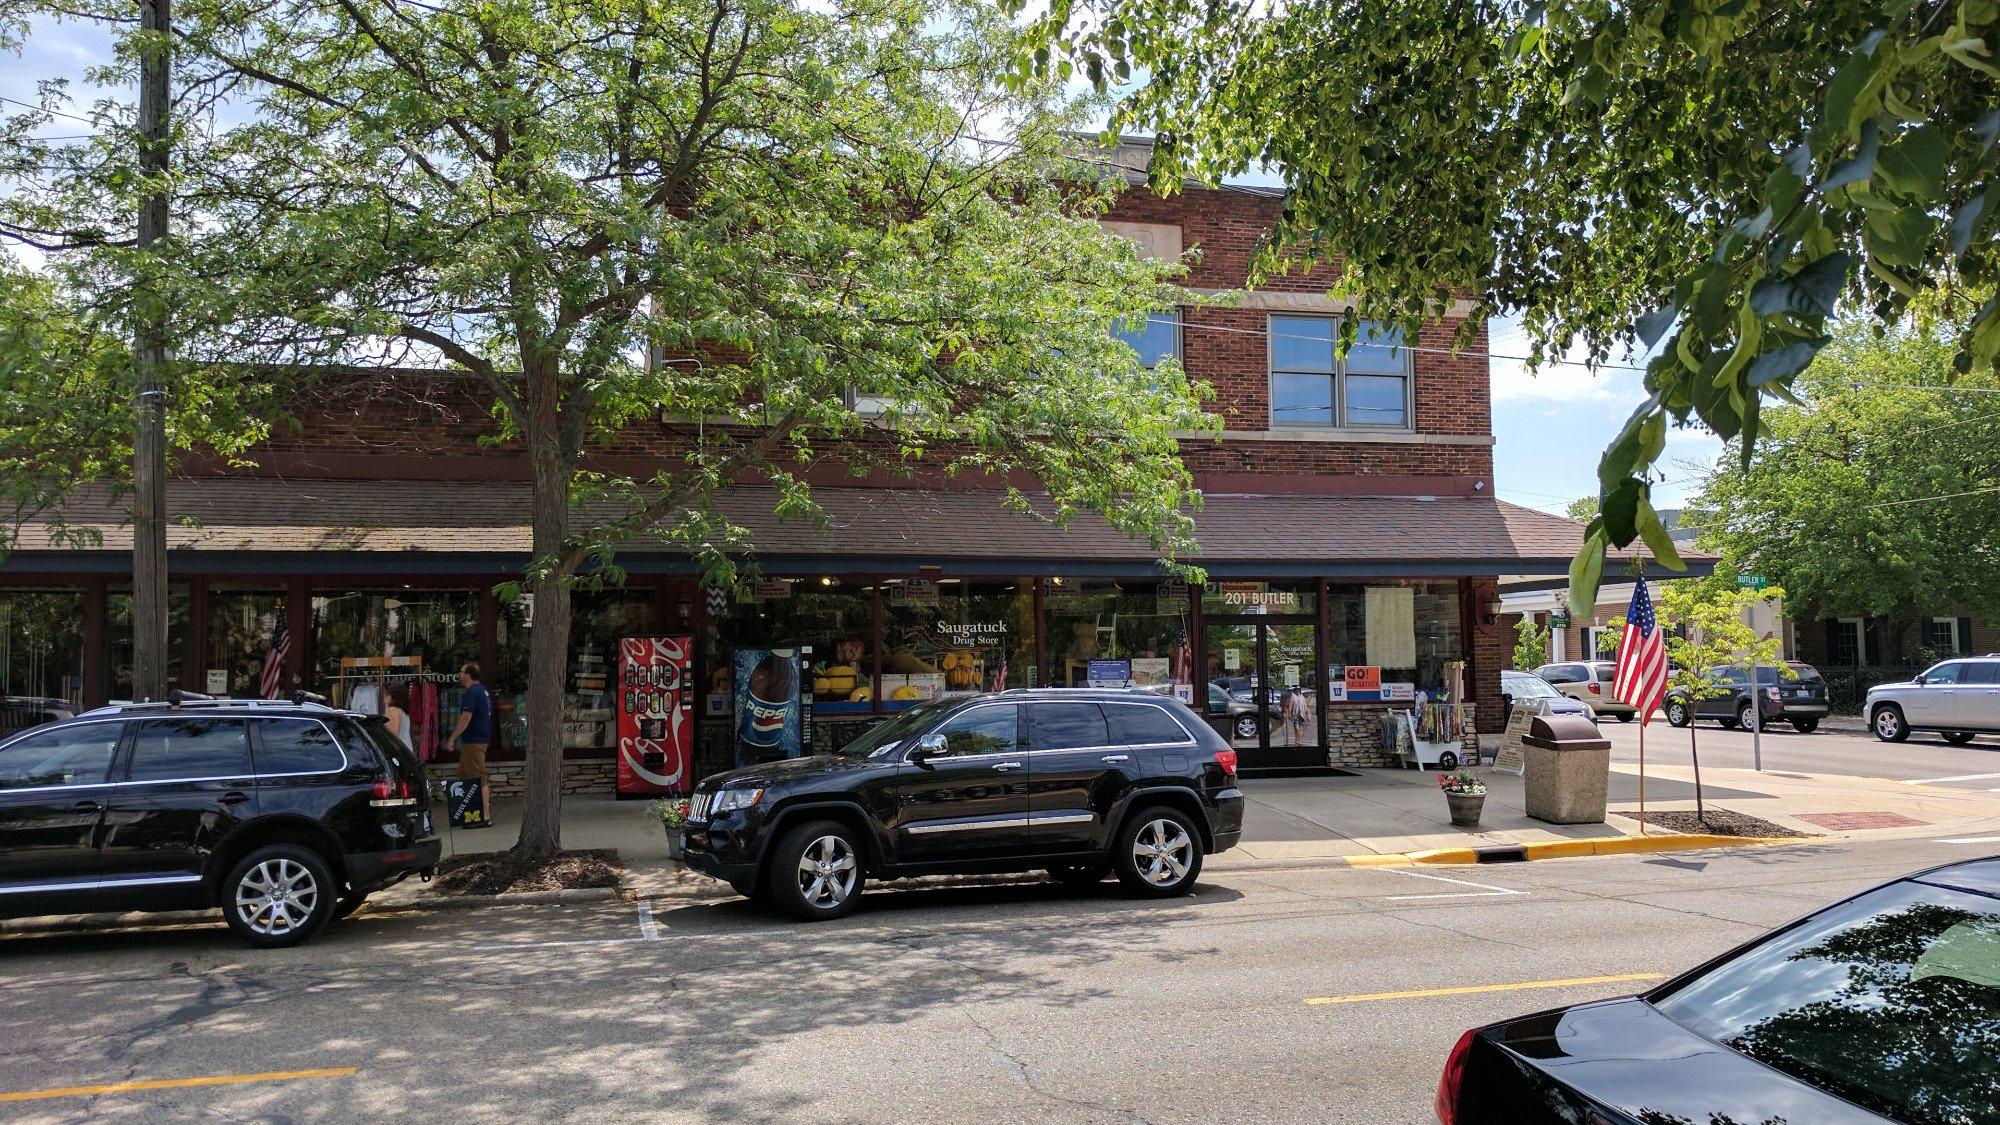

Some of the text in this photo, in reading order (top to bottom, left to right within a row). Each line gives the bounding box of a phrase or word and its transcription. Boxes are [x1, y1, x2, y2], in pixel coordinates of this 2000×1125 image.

[1737, 575, 1759, 584] BUTLER
[1225, 593, 1294, 605] 201 BUTLER
[937, 620, 1007, 638] Saugatuck
[953, 636, 999, 647] Drug Store
[1347, 668, 1369, 680] GO!
[746, 700, 788, 719] PEPSI
